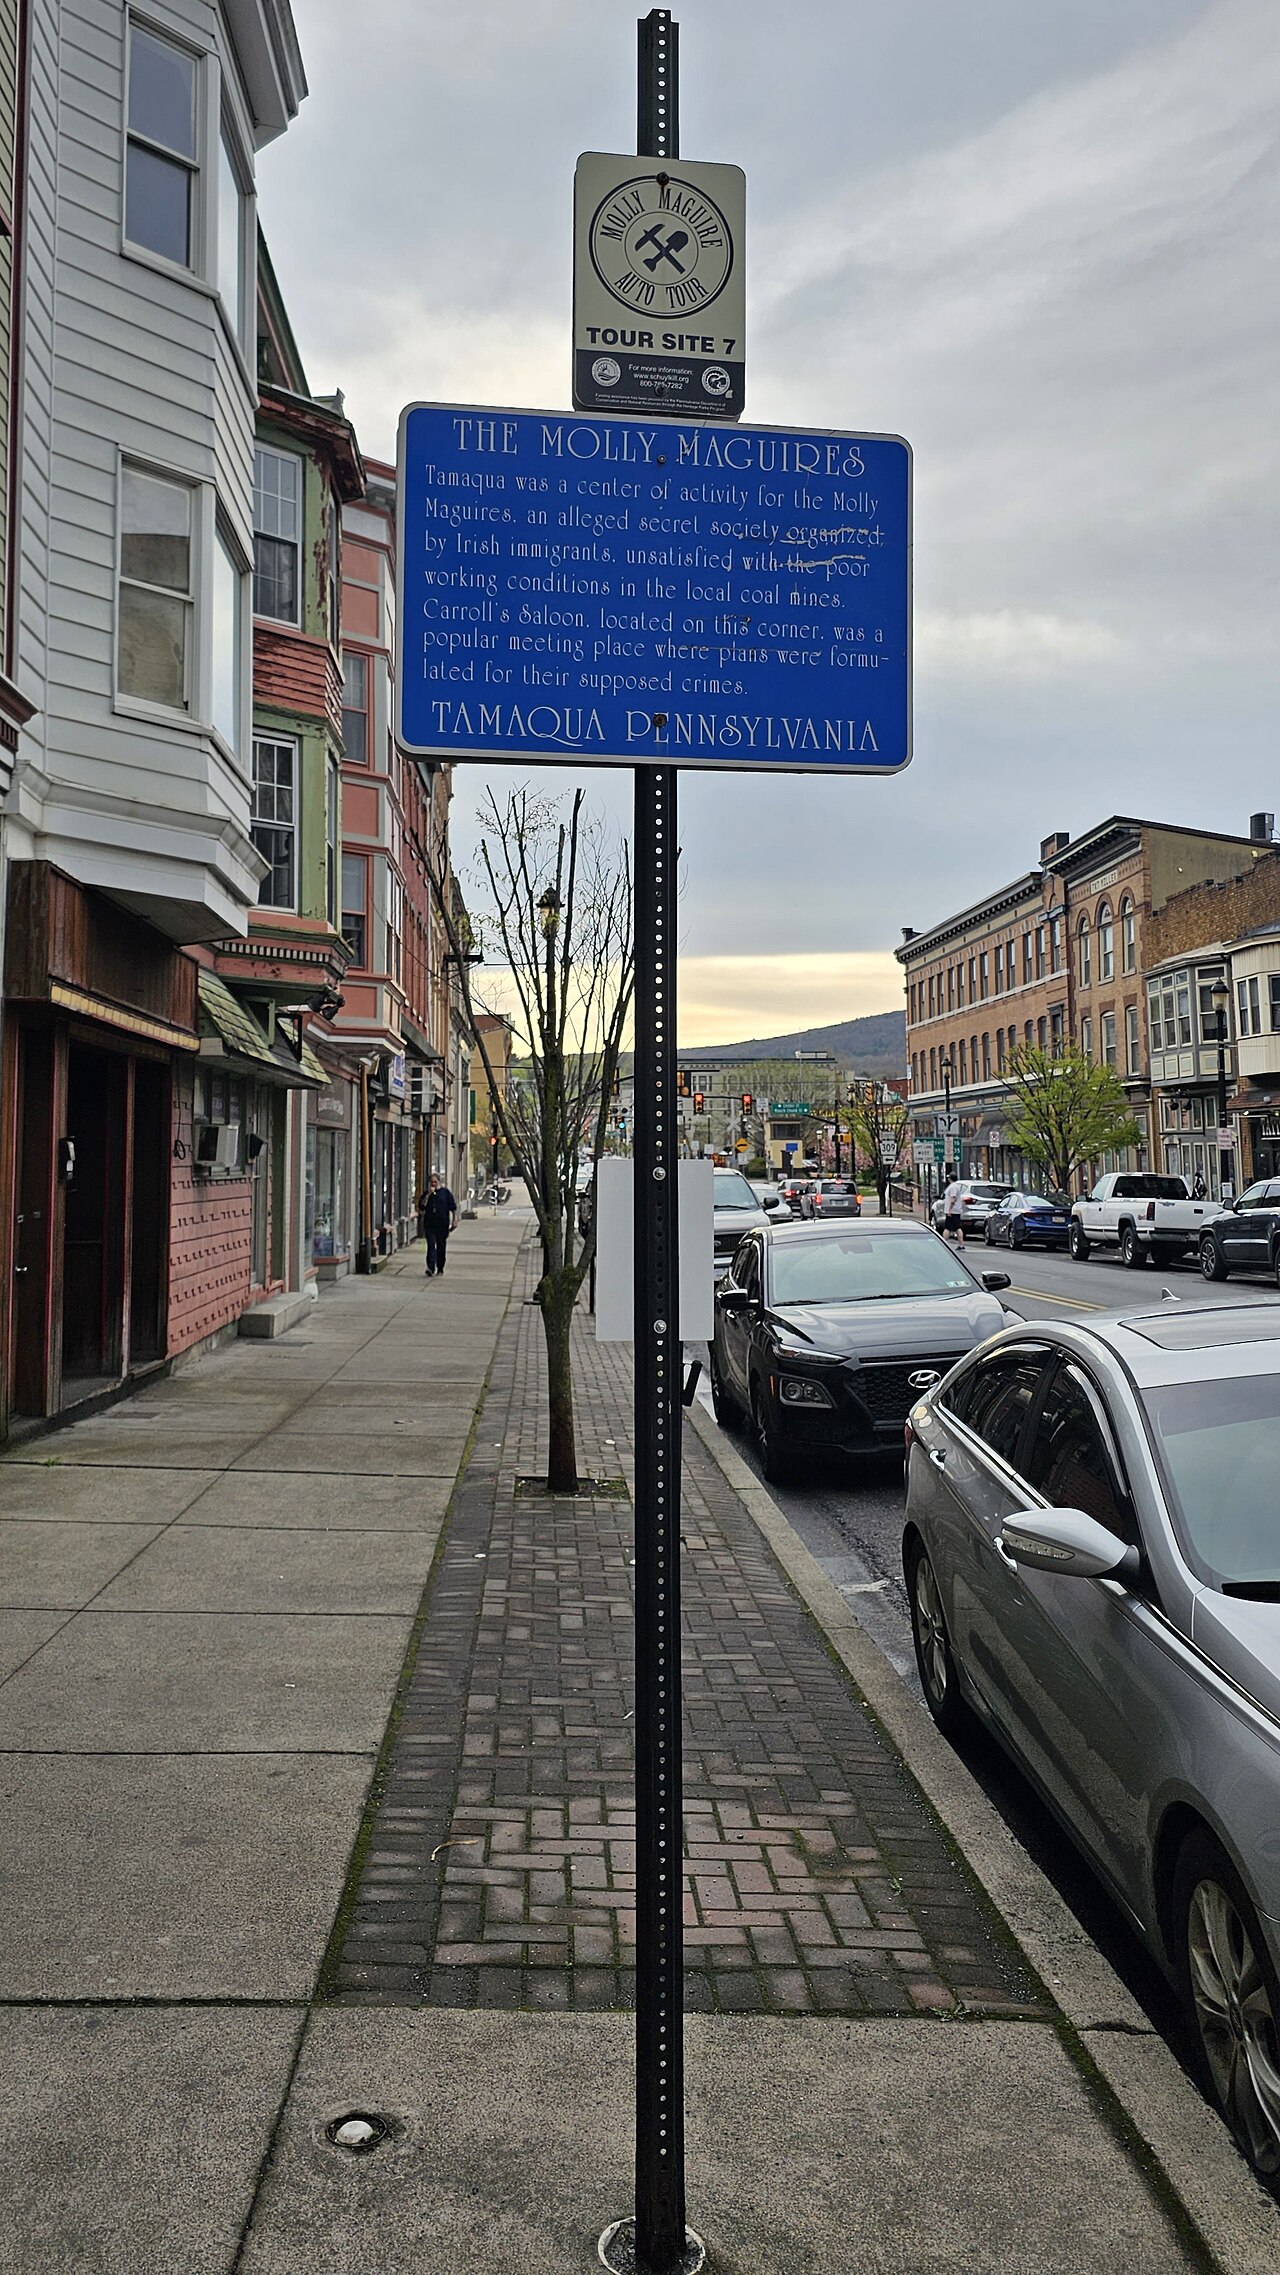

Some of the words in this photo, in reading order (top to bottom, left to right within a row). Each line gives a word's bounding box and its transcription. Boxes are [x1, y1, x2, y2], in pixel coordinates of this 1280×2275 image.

[600, 189, 646, 242] MOLLY
[658, 188, 723, 249] MAGUIRE
[614, 271, 656, 306] AUTO
[665, 277, 709, 309] TOUR
[586, 326, 654, 349] TOUR
[661, 333, 715, 354] SITE
[722, 338, 736, 355] 7
[628, 363, 640, 371] For
[658, 366, 694, 376] information:
[633, 373, 690, 384] www.schuylkill.org
[453, 418, 518, 455] THE
[540, 424, 658, 463] MOLLY
[677, 431, 865, 478] MAGUIRES
[425, 464, 505, 495] Tamaqua
[515, 476, 549, 492] was
[558, 479, 567, 493] a
[577, 477, 640, 498] center
[650, 478, 672, 500] of
[680, 483, 749, 512] activity
[758, 484, 785, 507] for
[794, 487, 823, 510] the
[833, 491, 879, 520] Molly
[527, 510, 547, 525] an
[558, 505, 628, 537] alleged
[638, 515, 698, 534] secret
[710, 519, 779, 546] society
[425, 529, 447, 559] by
[457, 532, 500, 555] Irish
[626, 545, 733, 572] unsatisfied
[742, 550, 778, 572] with
[786, 552, 817, 574] the
[825, 559, 871, 582] poor
[424, 565, 498, 597] working
[507, 571, 610, 596] conditions
[621, 576, 636, 597] in
[646, 577, 676, 599] the
[687, 579, 731, 602] local
[740, 583, 779, 605] coal
[423, 598, 510, 623] Carroll's
[600, 607, 673, 632] located
[682, 618, 704, 634] on
[714, 614, 751, 636] this
[833, 626, 865, 642] was
[874, 628, 883, 643] a
[423, 627, 499, 654] popular
[509, 633, 584, 662] meeting
[594, 634, 645, 662] place
[654, 637, 710, 660] where
[719, 640, 769, 669] plans
[776, 650, 822, 666] were
[830, 644, 889, 668] formu-
[423, 657, 474, 681] lated
[485, 660, 513, 683] for
[523, 663, 570, 686] their
[578, 670, 672, 697] supposed
[681, 672, 748, 696] crimes.
[431, 700, 606, 747] TAMAQUA
[625, 710, 879, 752] PENNSYLVANIA
[882, 1143, 896, 1152] 309
